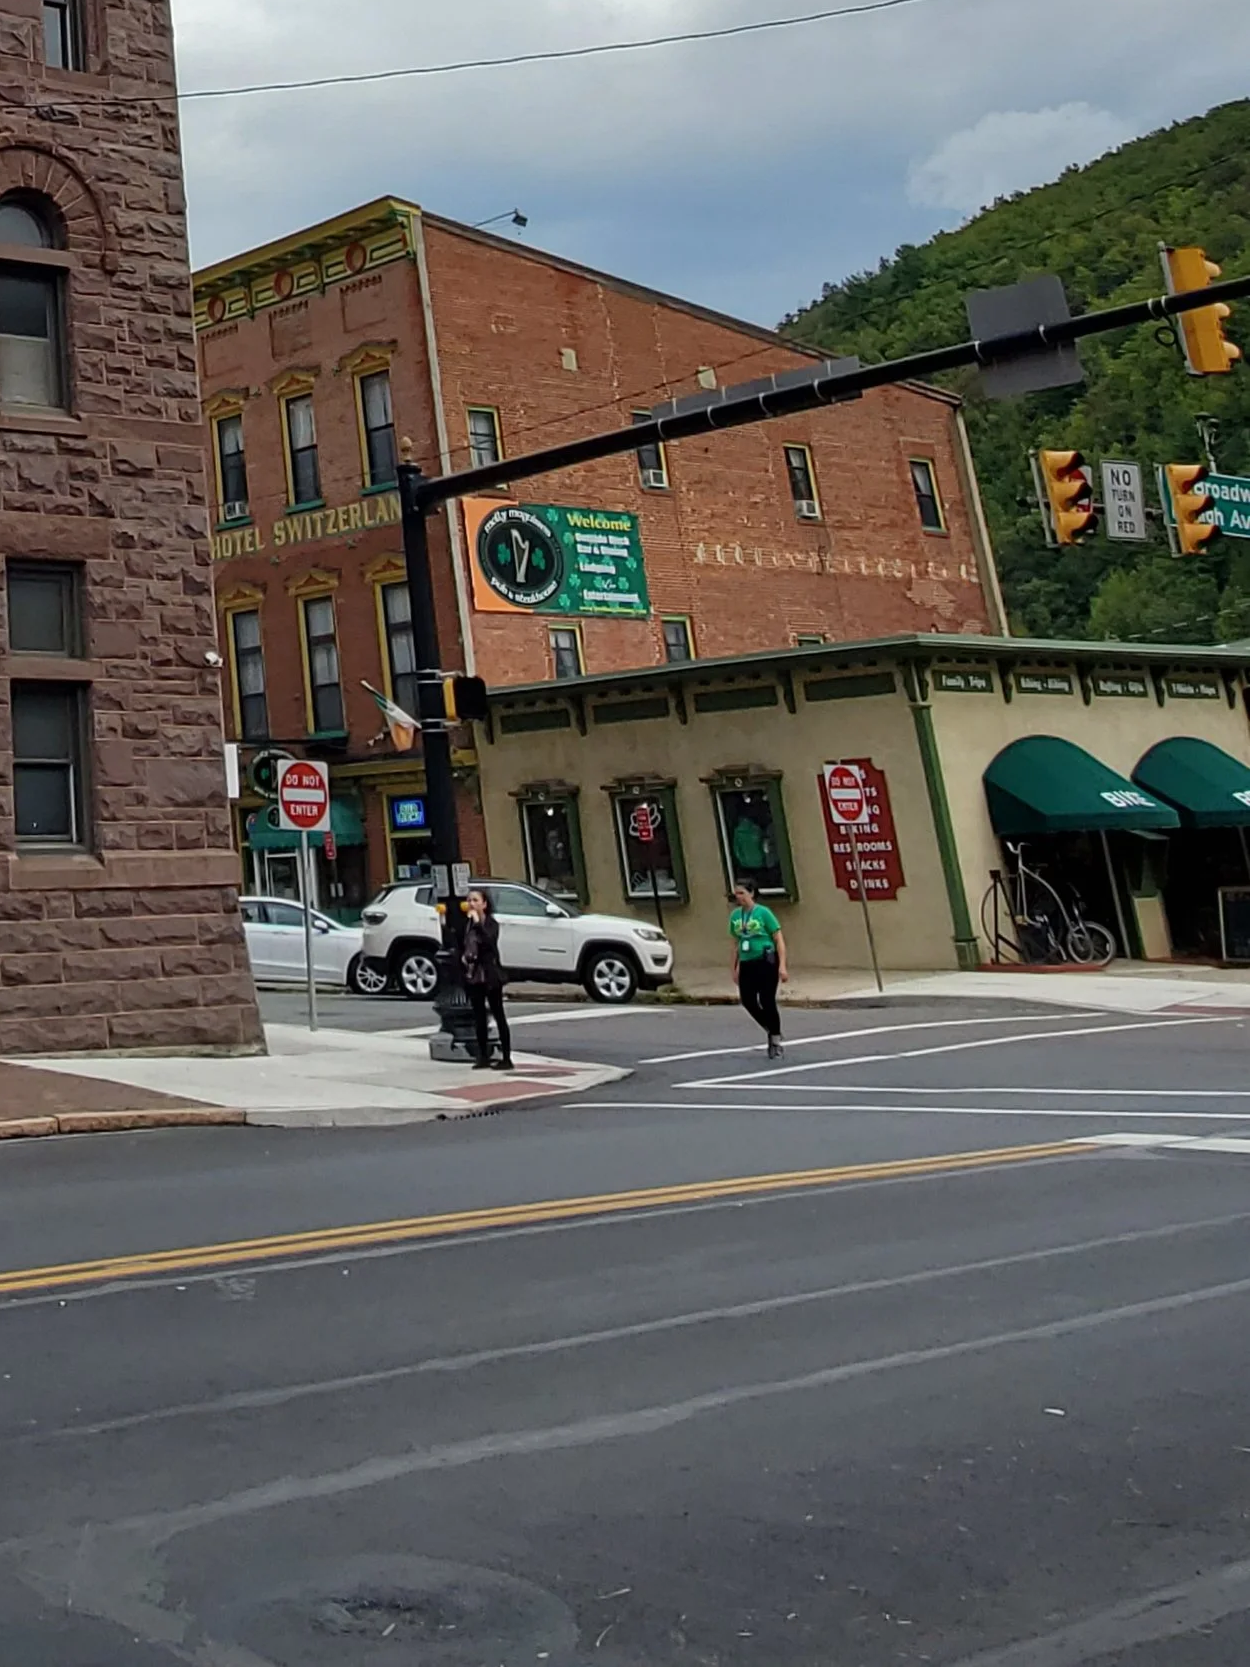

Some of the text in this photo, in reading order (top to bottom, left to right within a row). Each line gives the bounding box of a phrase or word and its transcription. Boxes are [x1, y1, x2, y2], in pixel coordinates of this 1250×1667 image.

[1110, 468, 1131, 486] NO
[1111, 489, 1135, 503] TURN
[1117, 505, 1132, 518] ON
[209, 494, 401, 560] HOTEL SWITZERLAN
[566, 512, 633, 532] Welcome
[1117, 521, 1136, 534] RED
[285, 774, 320, 787] DO NOT
[290, 804, 319, 816] ENTER
[839, 823, 879, 835] BKING
[833, 840, 892, 853] RESROOMS
[850, 879, 889, 890] DINKS
